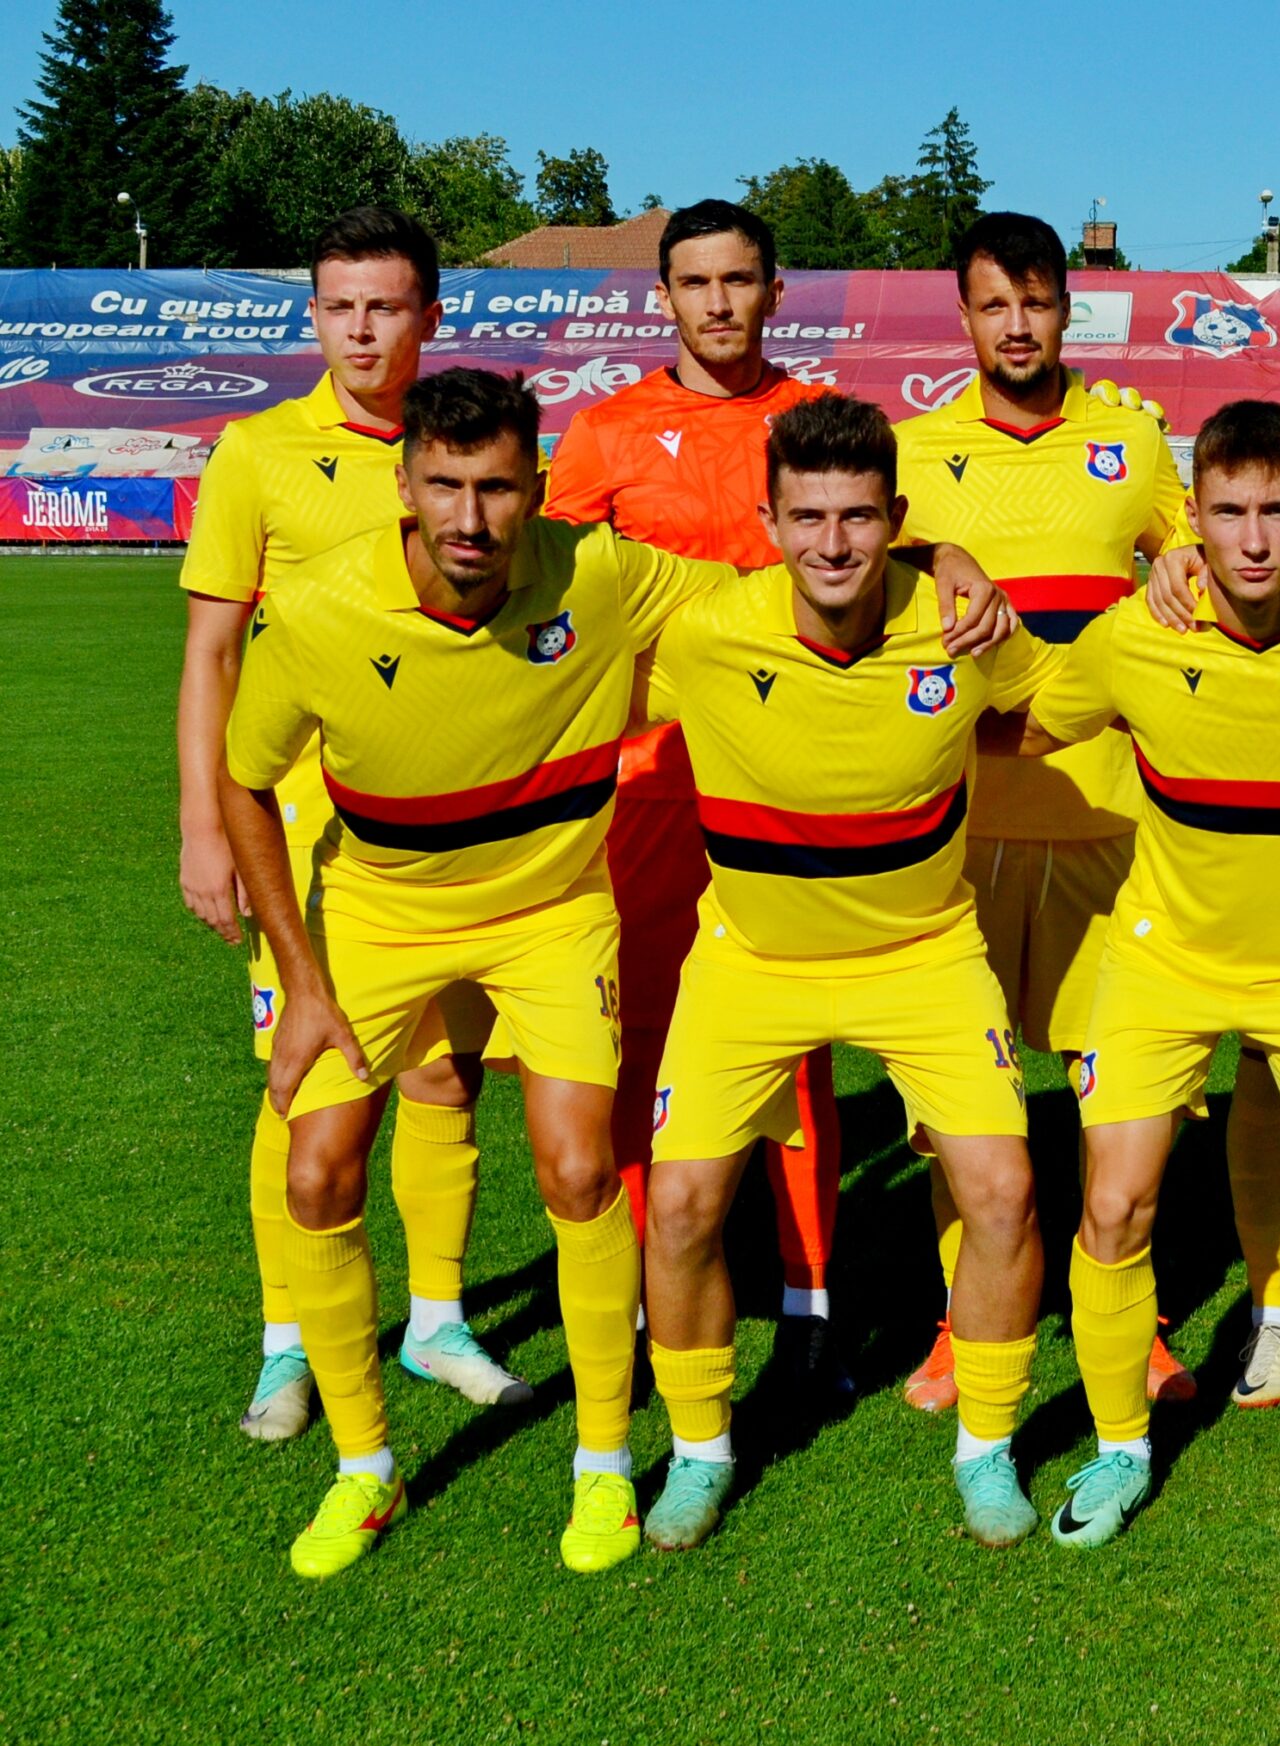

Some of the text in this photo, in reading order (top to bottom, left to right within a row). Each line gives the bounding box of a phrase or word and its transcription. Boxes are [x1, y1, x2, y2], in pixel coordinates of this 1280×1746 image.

[91, 290, 148, 315] Cu
[158, 299, 293, 321] gustul
[487, 289, 630, 317] echipă
[0, 320, 169, 339] uropean
[469, 321, 548, 339] F.C.
[563, 322, 678, 339] Bihor
[103, 379, 242, 393] REGAL
